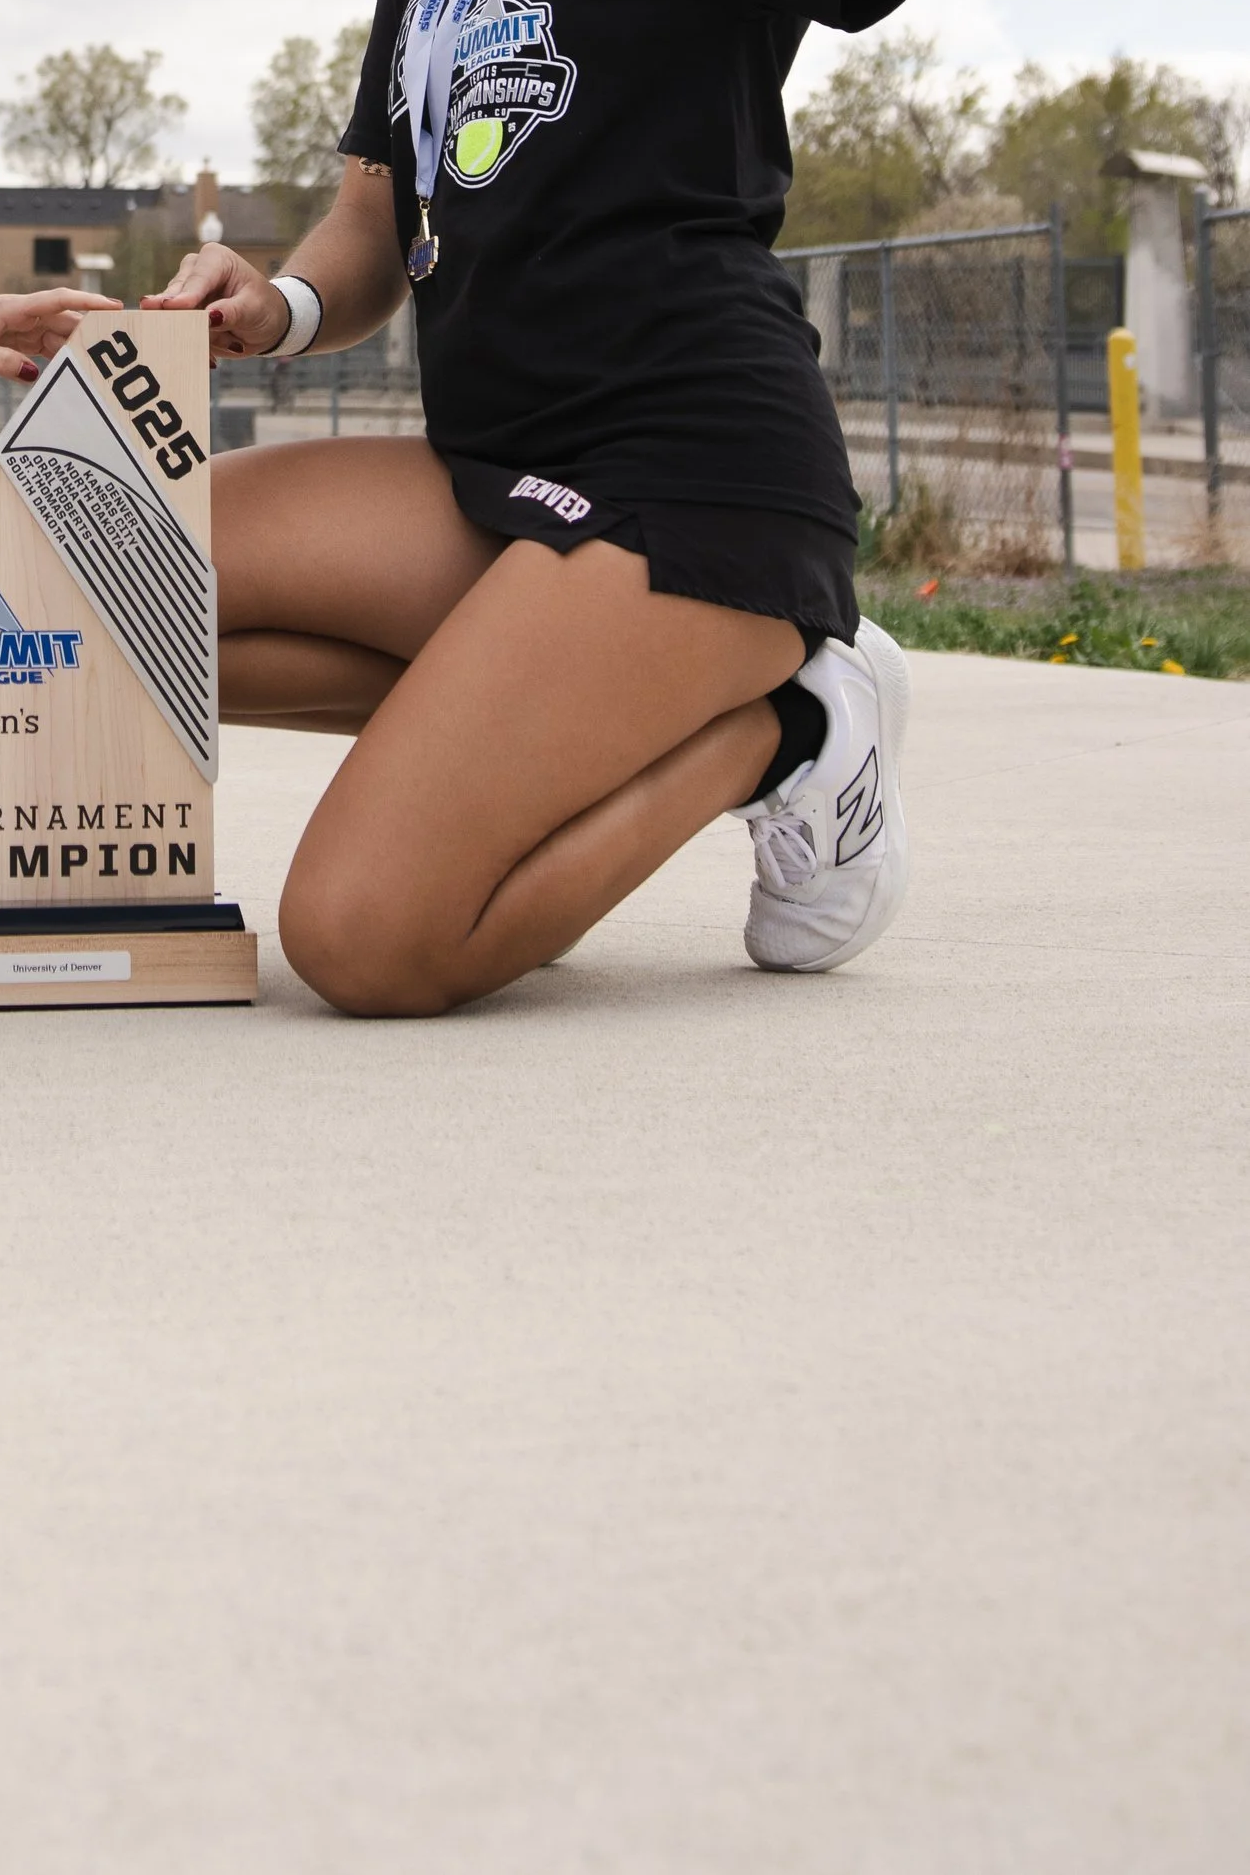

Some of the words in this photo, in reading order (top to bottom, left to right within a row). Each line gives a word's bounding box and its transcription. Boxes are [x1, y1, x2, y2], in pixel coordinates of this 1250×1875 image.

[465, 46, 510, 72] LEAGUE
[470, 65, 497, 87] TENNIS
[494, 108, 507, 117] CO
[87, 330, 207, 480] 2025
[6, 456, 36, 497] SOUTH
[32, 497, 67, 544] DAKOTA
[19, 454, 32, 473] ST.
[30, 471, 67, 521] THOMAS
[33, 454, 54, 486] ORAL
[53, 487, 93, 540] ROBERTS
[47, 457, 79, 501] OMAHA
[508, 474, 592, 523] DENVER
[63, 461, 95, 503] NORTH
[90, 503, 124, 552] DAKOTA
[82, 470, 118, 519] KANSAS
[114, 514, 138, 552] CITY
[104, 482, 138, 530] DENVER
[12, 963, 56, 974] University
[59, 963, 68, 972] of
[70, 962, 102, 972] Denver
